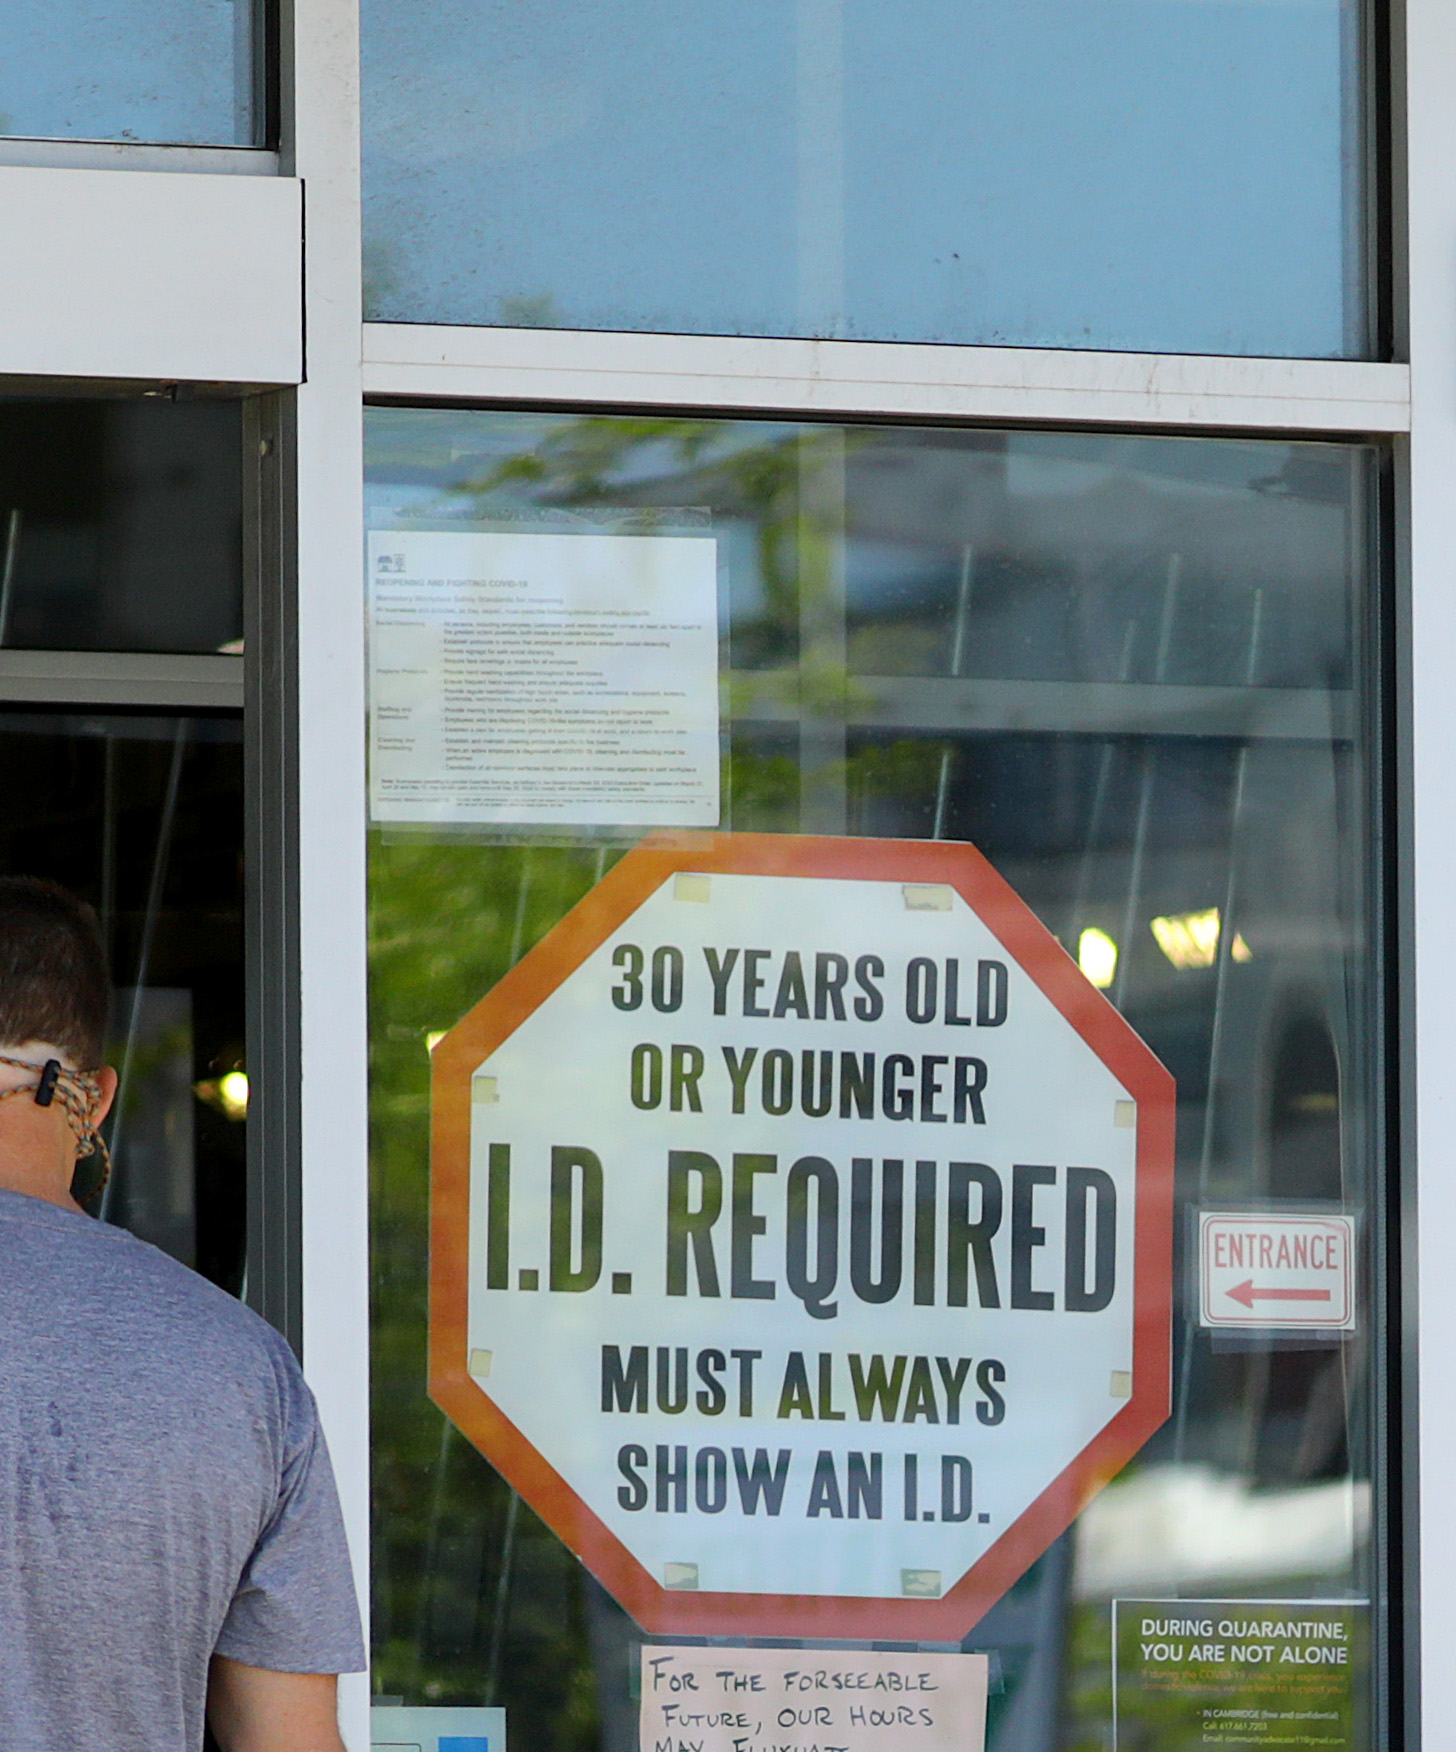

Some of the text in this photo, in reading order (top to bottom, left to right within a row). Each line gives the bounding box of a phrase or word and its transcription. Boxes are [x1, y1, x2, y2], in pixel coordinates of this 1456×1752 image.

[610, 943, 1009, 1029] 30 YEARS OLD
[630, 1043, 989, 1125] OR YOUNGER
[486, 1142, 1117, 1321] I.D. REQUIRED
[1214, 1233, 1338, 1270] ENTRANCE
[601, 1344, 1007, 1426] MUST ALWAYS
[617, 1443, 991, 1526] SHOW AN I.D.
[1141, 1618, 1348, 1642] DURING QUARANTINE,
[1141, 1643, 1348, 1664] YOU ARE NOT ALONE
[649, 1656, 940, 1693] FOR THE FORSEEABLE
[661, 1704, 934, 1735] FUTURE, OUR HOURS
